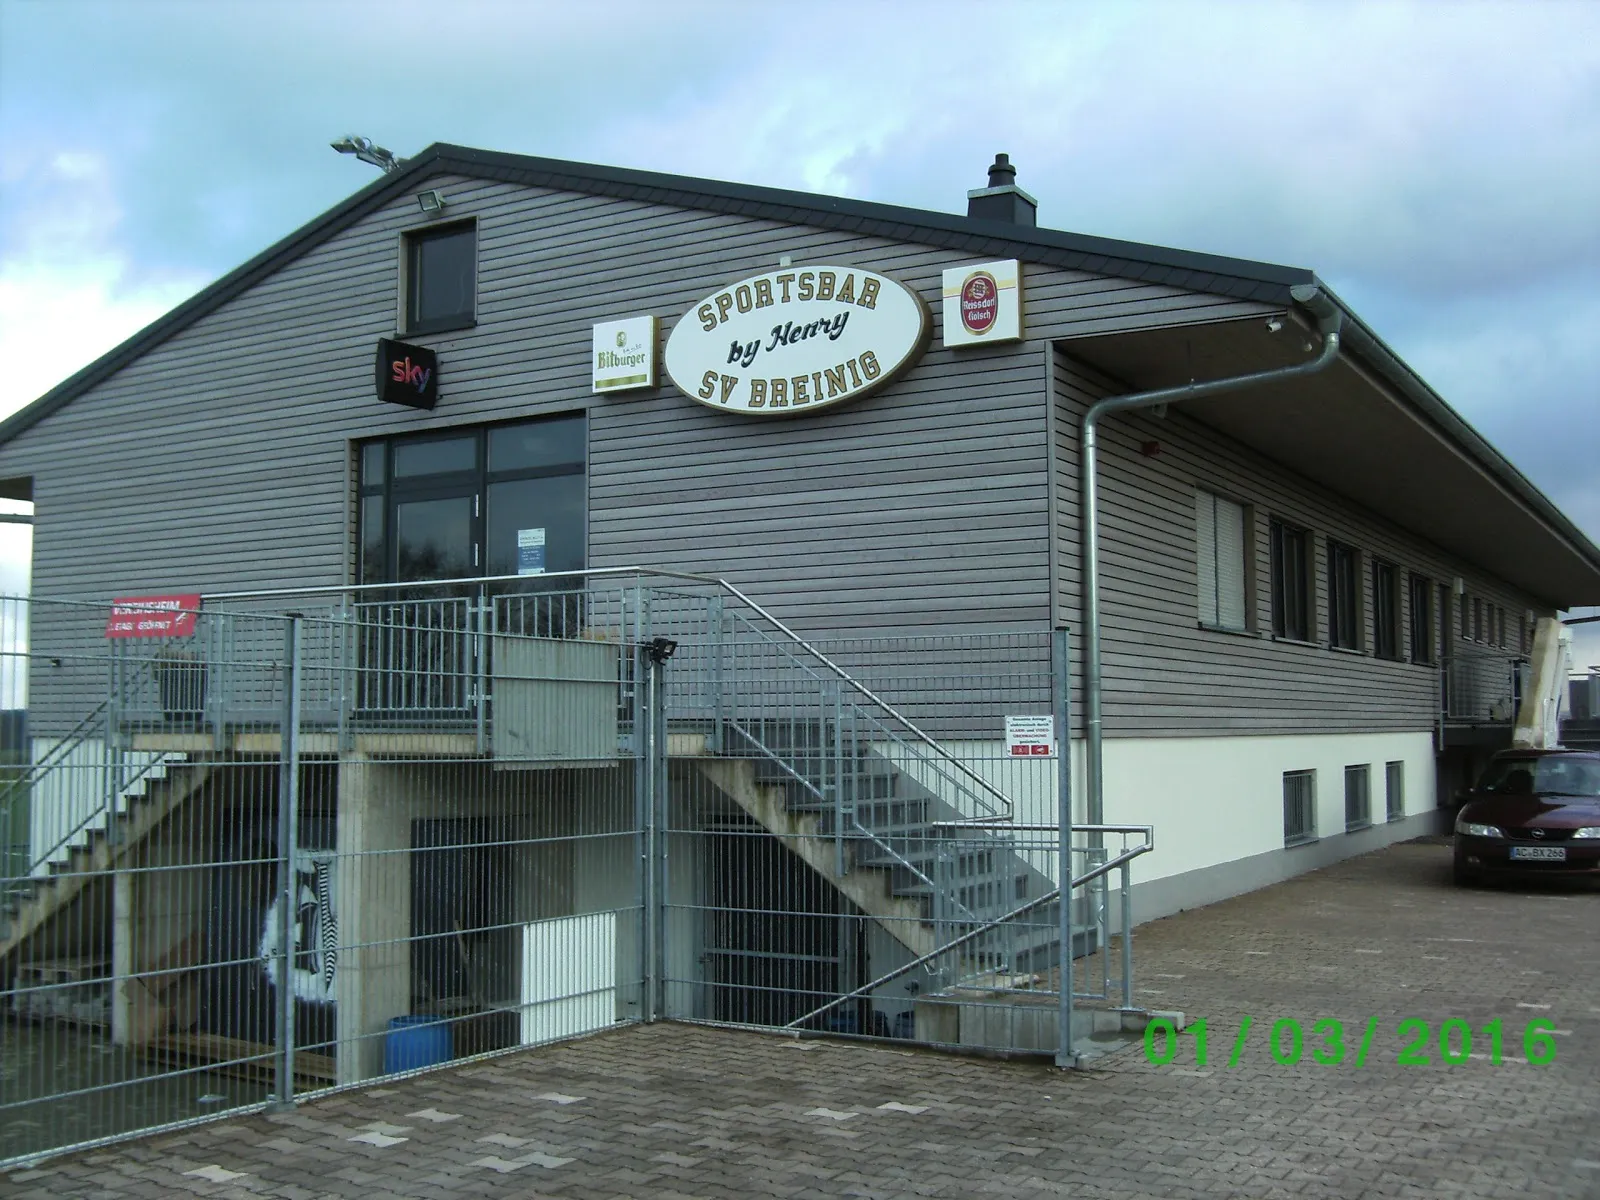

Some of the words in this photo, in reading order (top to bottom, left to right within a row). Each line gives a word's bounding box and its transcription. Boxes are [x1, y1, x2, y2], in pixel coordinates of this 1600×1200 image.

[697, 271, 881, 332] SPORTSBAR
[597, 350, 646, 370] Bitburger
[727, 339, 761, 368] by
[766, 310, 850, 352] Henry
[392, 356, 431, 393] sky
[698, 370, 739, 404] SV
[748, 350, 882, 408] BREINIG
